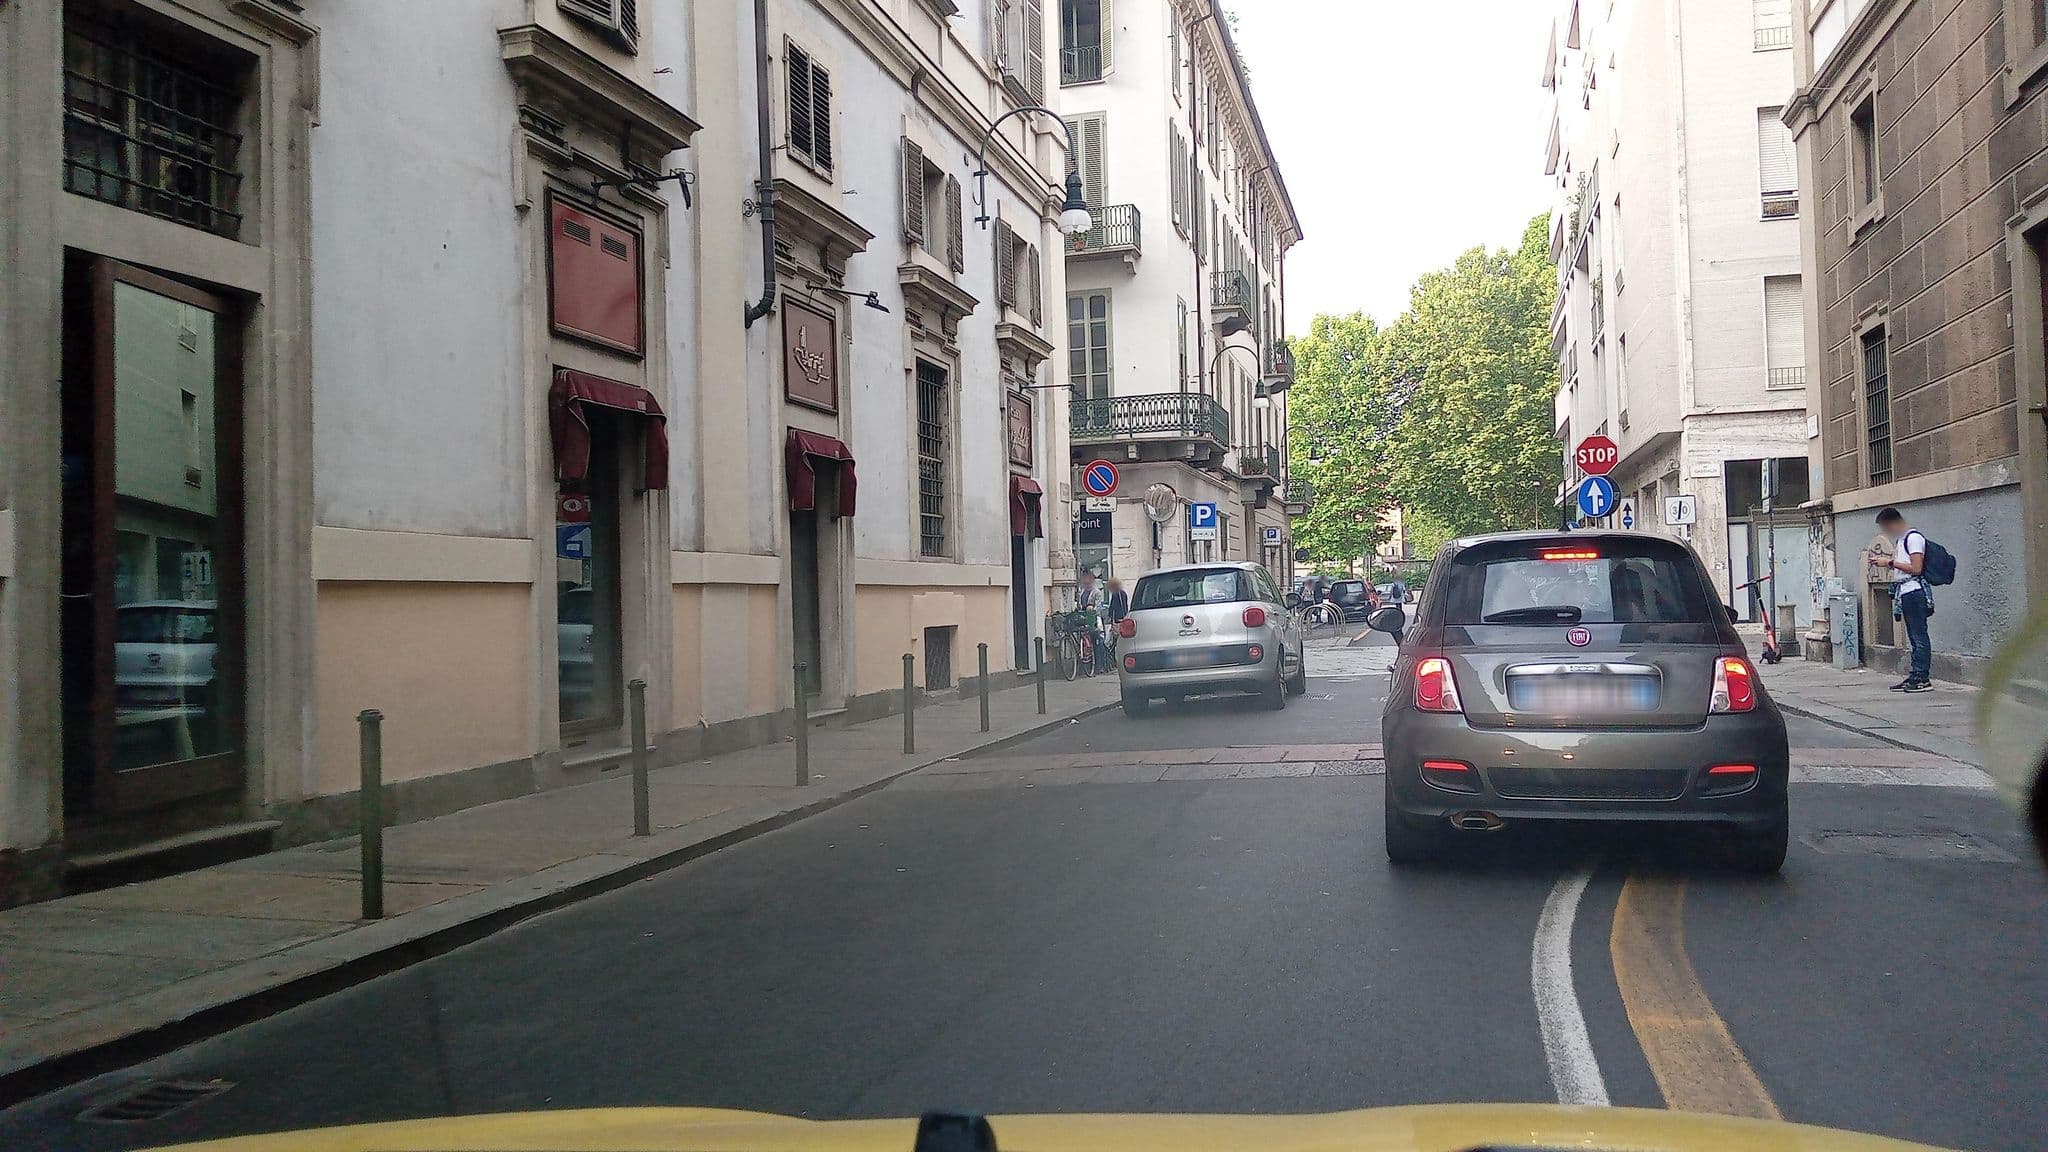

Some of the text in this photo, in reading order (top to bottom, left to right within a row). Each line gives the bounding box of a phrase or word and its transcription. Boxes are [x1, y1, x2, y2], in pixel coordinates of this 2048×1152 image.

[1578, 447, 1616, 464] STOP
[1196, 505, 1212, 526] P
[1268, 530, 1275, 538] P
[1572, 632, 1585, 641] FIAT
